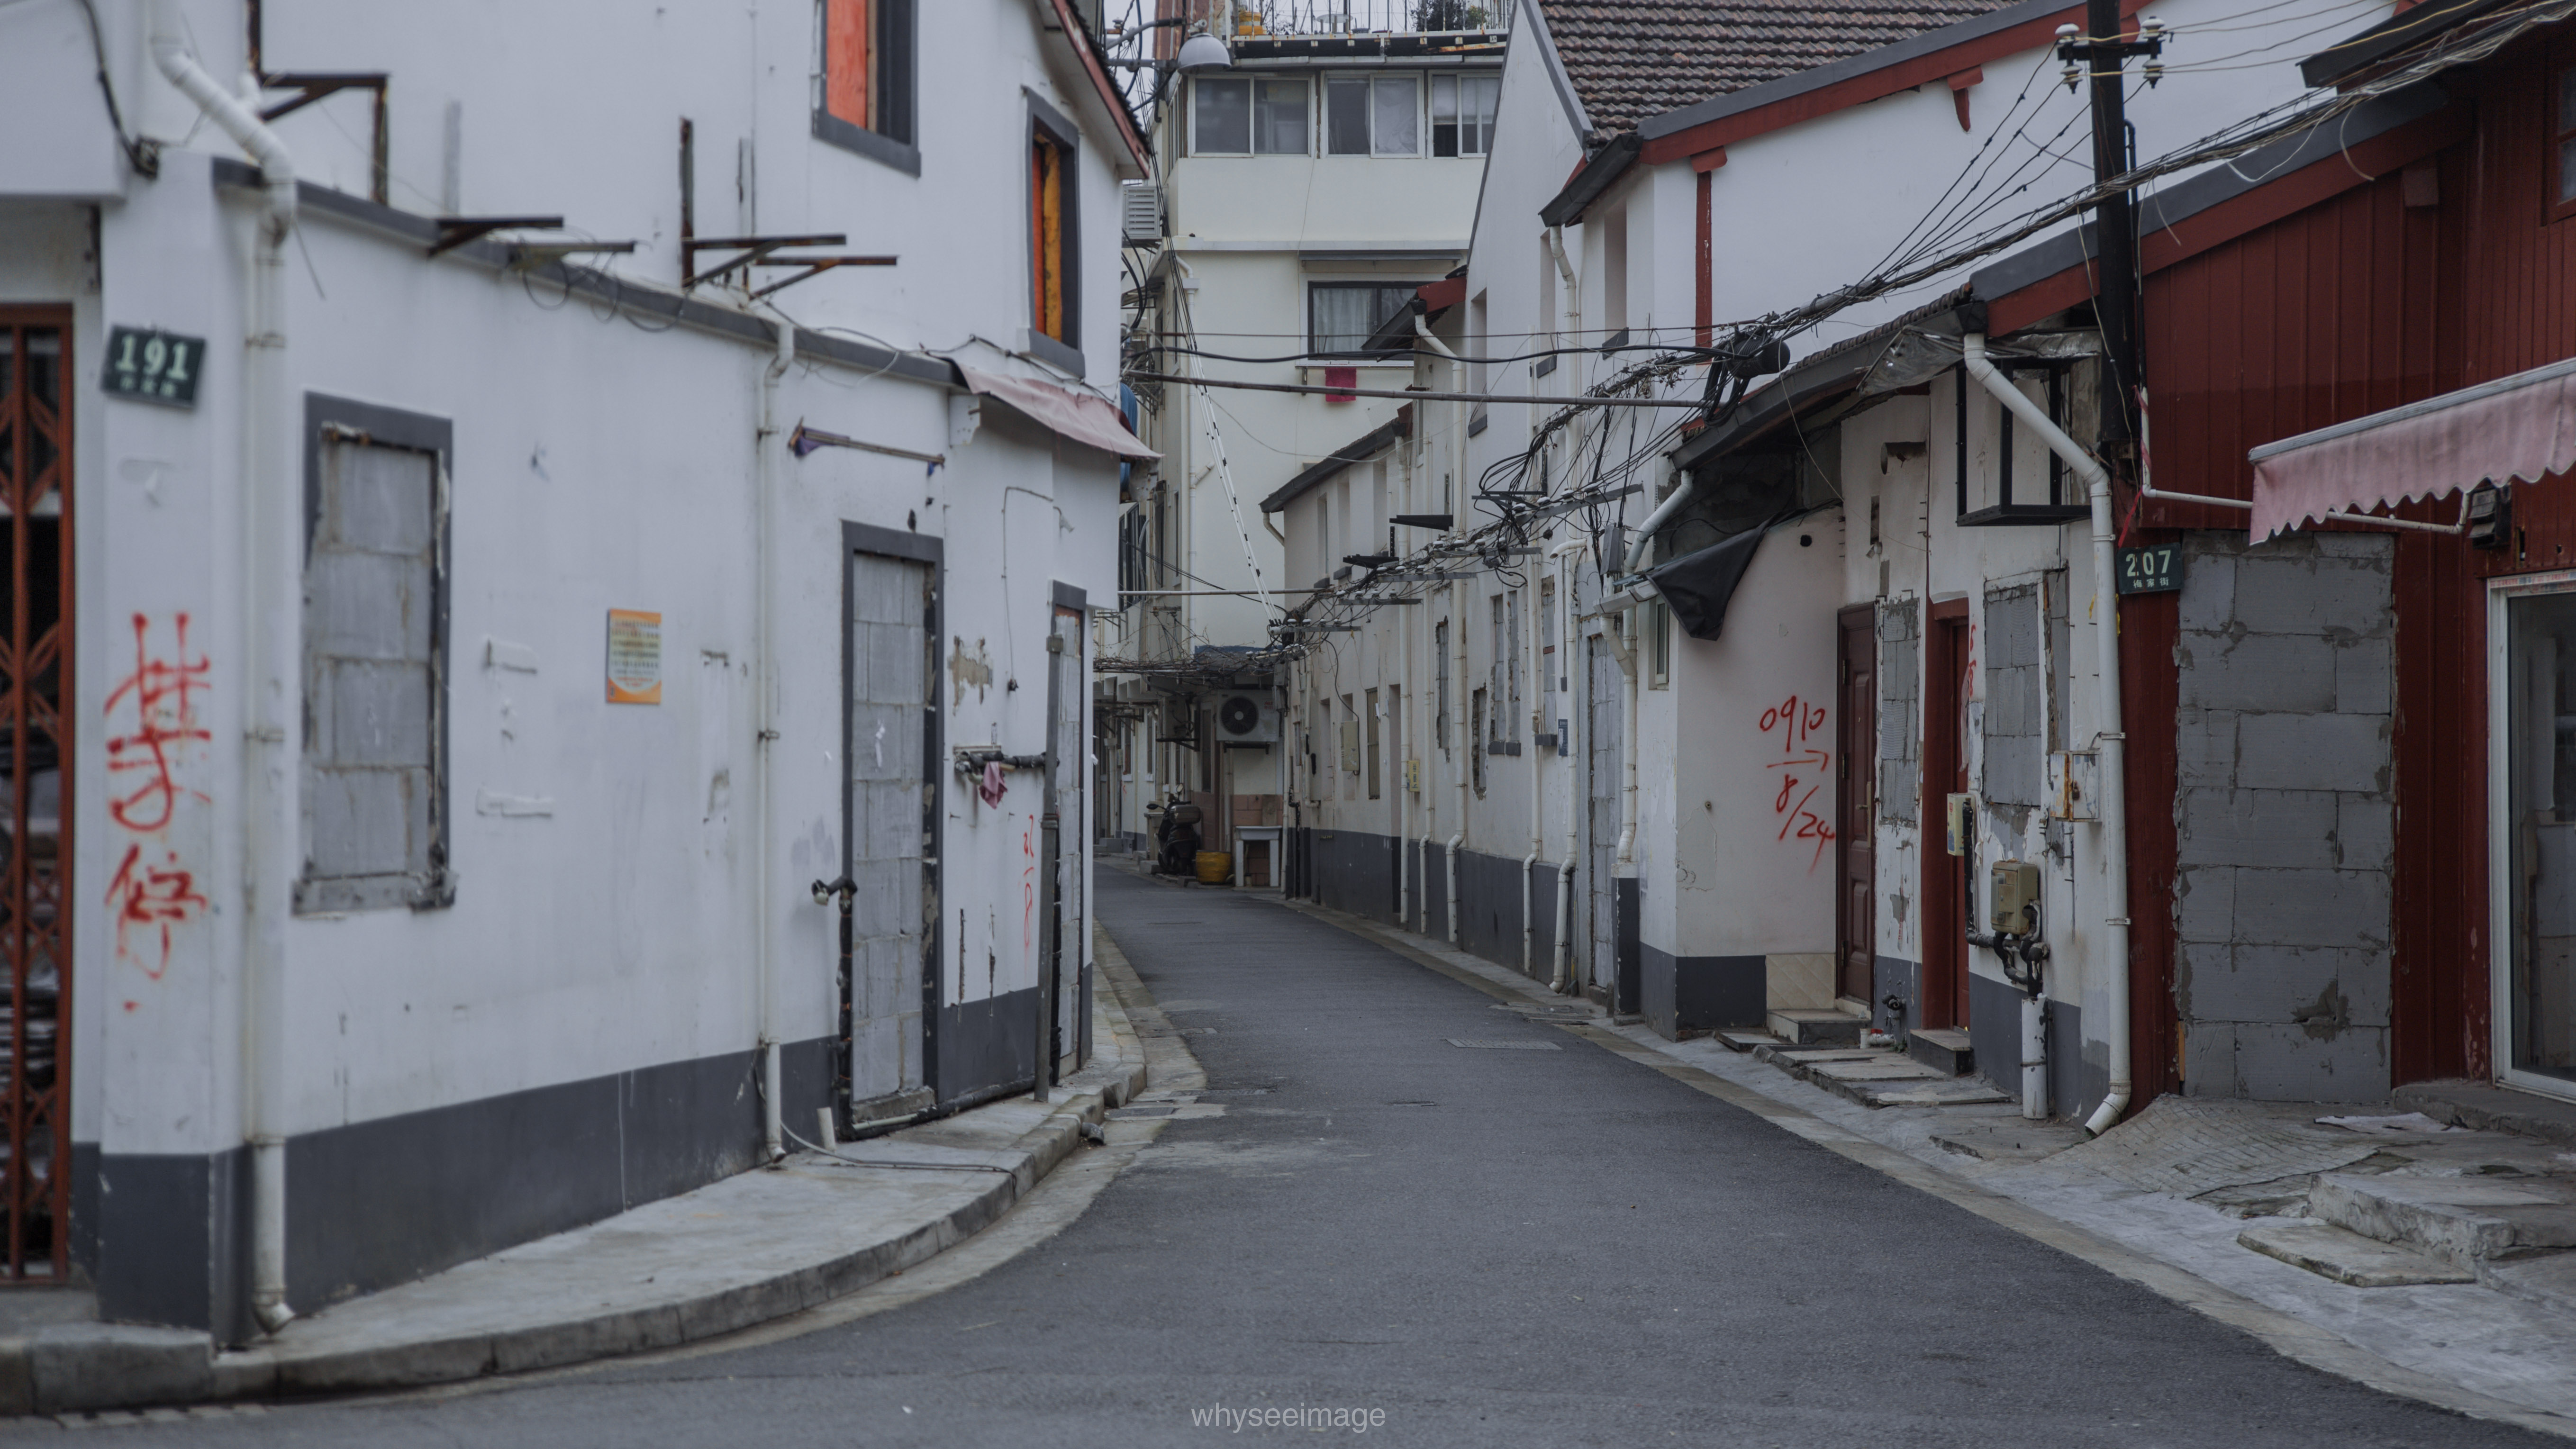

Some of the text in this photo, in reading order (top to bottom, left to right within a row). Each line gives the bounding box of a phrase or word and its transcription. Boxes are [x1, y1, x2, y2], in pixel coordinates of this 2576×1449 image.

[115, 334, 188, 380] 191
[2126, 550, 2171, 577] 207
[2133, 577, 2169, 589] 梅家街
[1760, 695, 1826, 752] 0910
